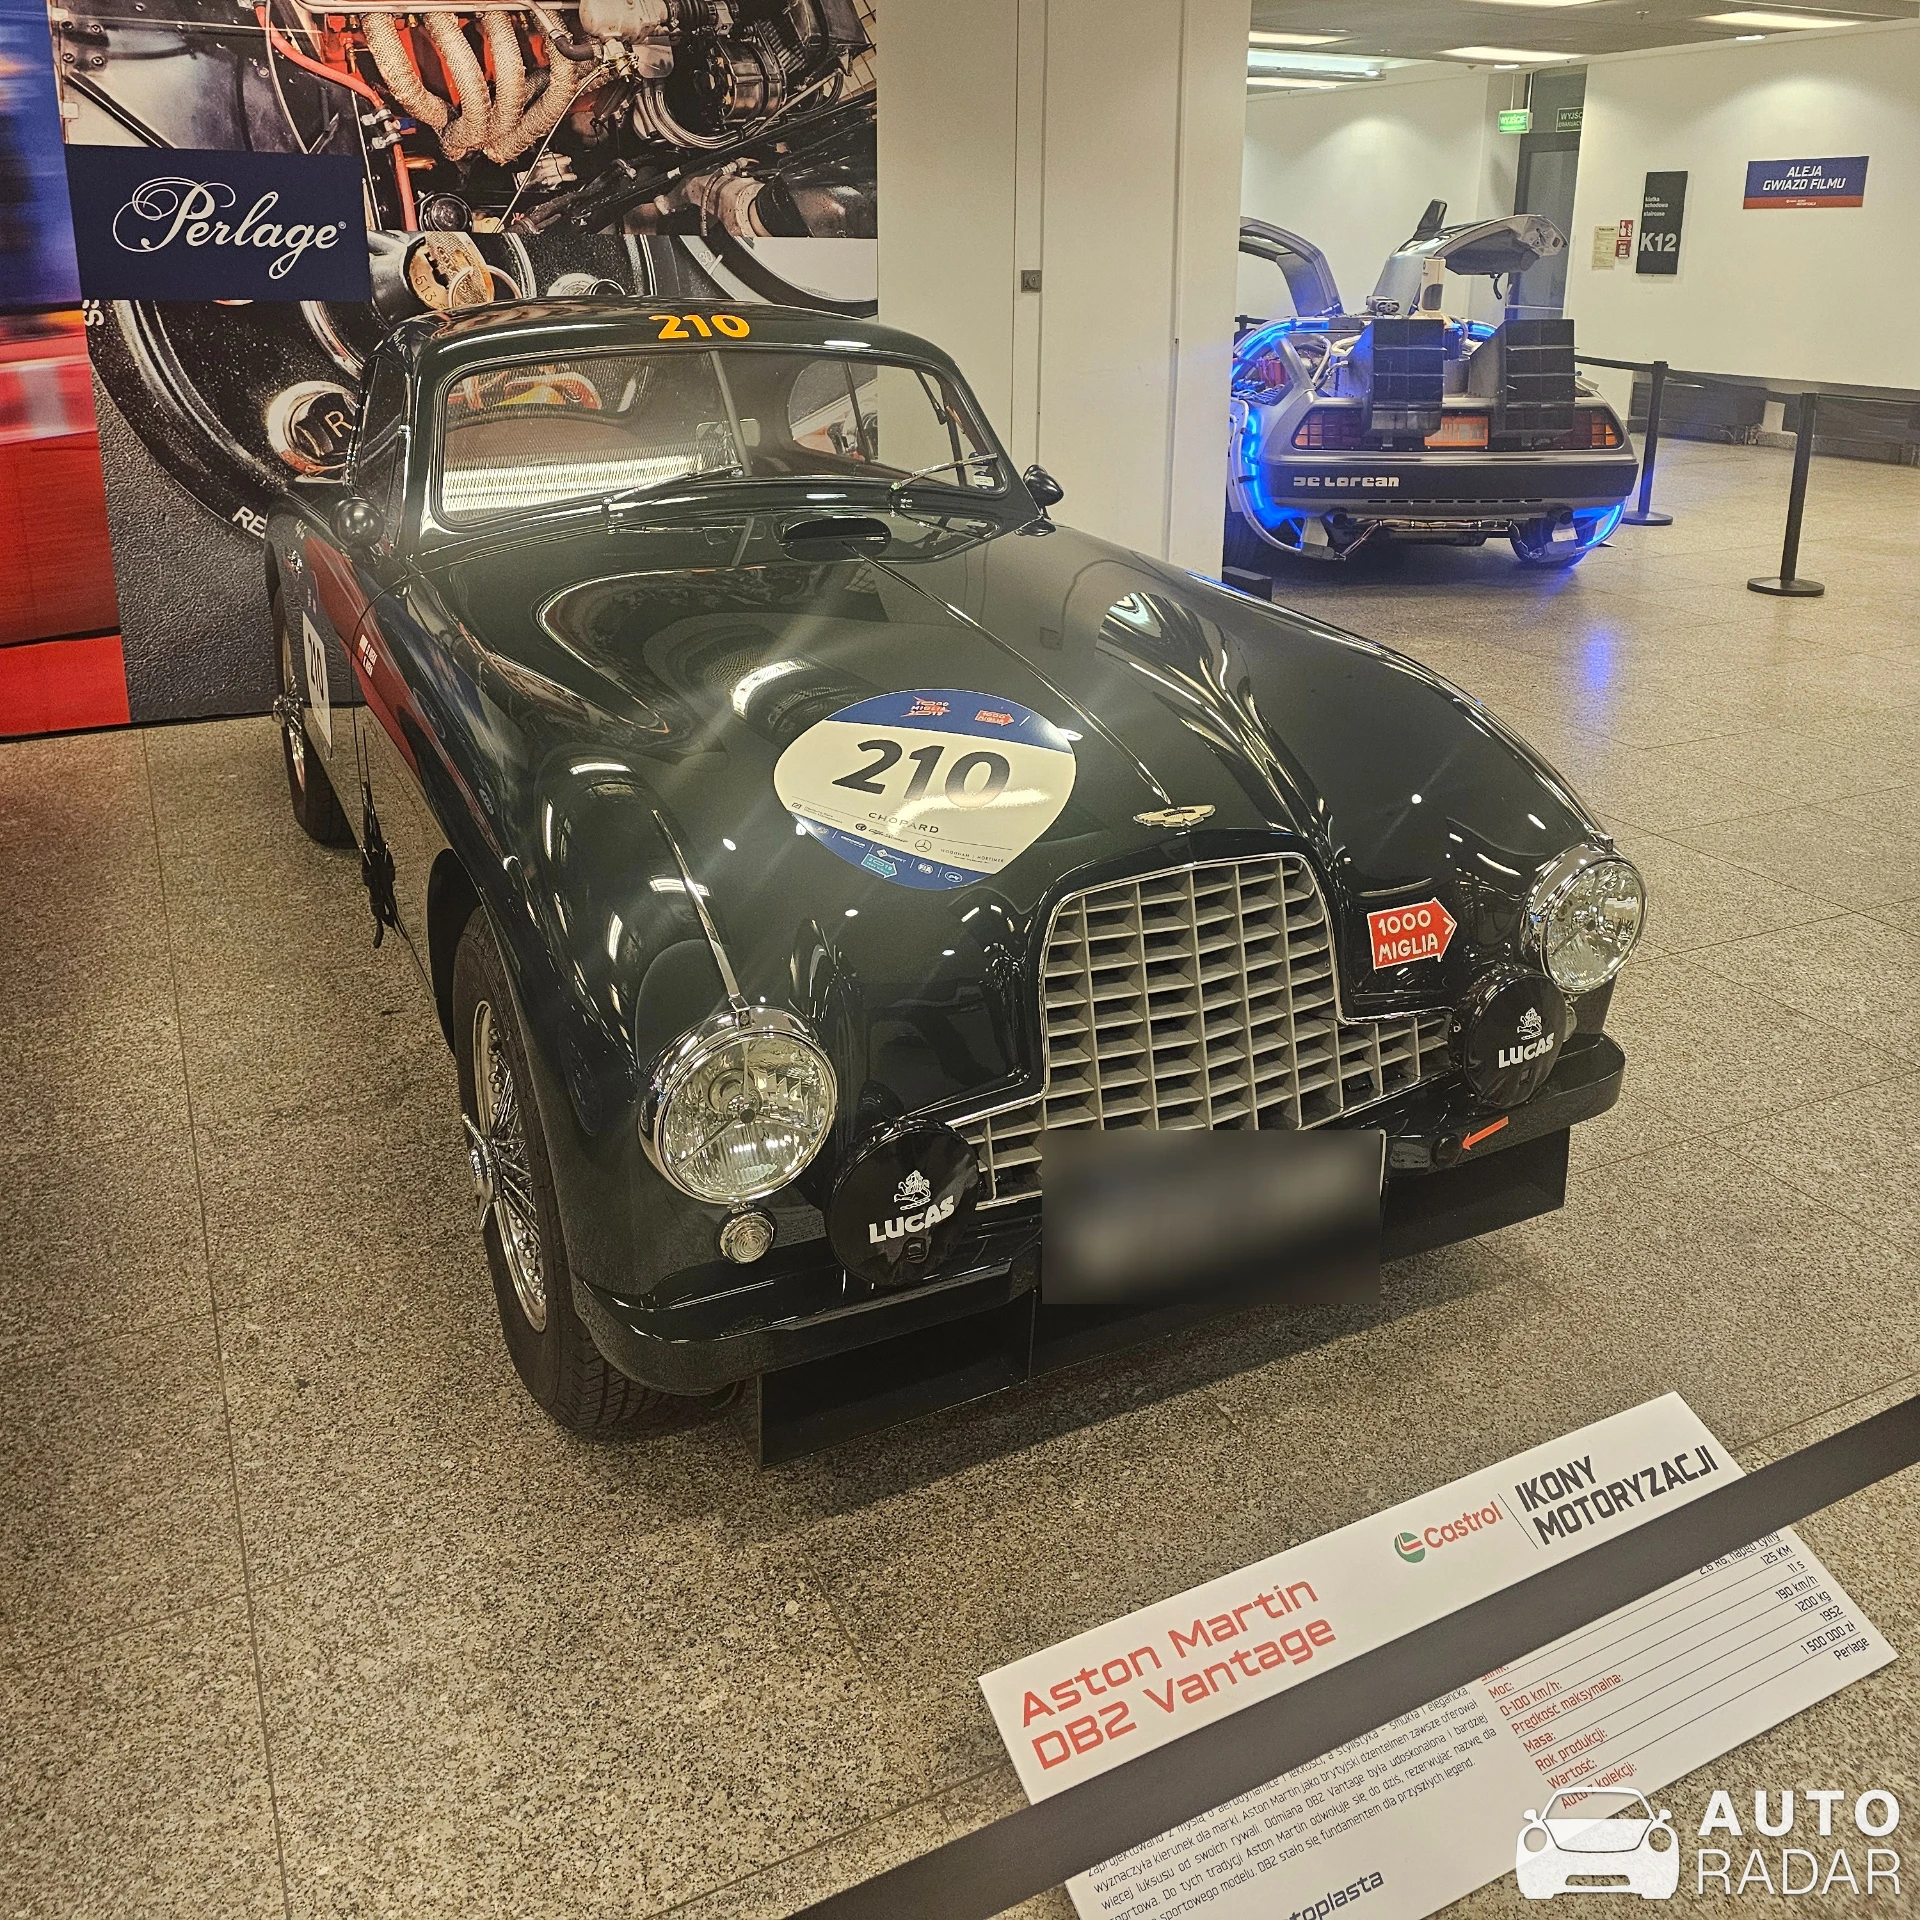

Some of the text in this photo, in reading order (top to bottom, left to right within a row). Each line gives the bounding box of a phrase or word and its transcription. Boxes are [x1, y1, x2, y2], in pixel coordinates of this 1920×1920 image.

[1763, 178, 1846, 191] GWIAZD FILMU
[1787, 166, 1822, 177] ALEJA
[1640, 232, 1677, 252] K12
[648, 314, 750, 340] 210
[831, 739, 1011, 809] 210
[868, 812, 940, 834] CHOPARD
[1378, 909, 1431, 936] 1000
[1378, 933, 1438, 963] MIGLIA
[1498, 1033, 1555, 1069] LUCAS
[868, 1195, 955, 1244] LUCAS
[1514, 1455, 1599, 1513] IKONY
[1532, 1445, 1719, 1546] MOTORYZACJI
[1423, 1501, 1503, 1549] Castrol
[1760, 1544, 1793, 1566] 125 KM
[1787, 1561, 1806, 1574] 11 s
[1775, 1574, 1819, 1600] 190 km/h
[1795, 1590, 1832, 1612] 1200 kg
[1819, 1605, 1844, 1622] 1952
[1800, 1621, 1856, 1655] 1 500 000 zł
[1833, 1637, 1870, 1661] Perlage
[1022, 1580, 1319, 1728] Aston Martin
[1031, 1618, 1337, 1771] DB2 Vantage
[1428, 1687, 1472, 1712] elegancka,
[1488, 1681, 1515, 1699] Moc:
[1500, 1680, 1563, 1717] 0-100 km/h:
[1511, 1673, 1624, 1735] Prędkość maksymalna:
[1522, 1731, 1556, 1753] Masa:
[1535, 1727, 1609, 1772] Rok produkcji:
[1547, 1757, 1598, 1789] Wartość:
[1595, 1761, 1638, 1788] kolekcji:
[1094, 1857, 1153, 1894] wyznaczyła
[1153, 1836, 1196, 1865] kierunek
[1196, 1830, 1212, 1844] dla
[1212, 1814, 1242, 1836] marki.
[1242, 1801, 1271, 1821] Aston
[1270, 1781, 1302, 1807] Martin
[1302, 1776, 1321, 1794] jako
[1320, 1757, 1360, 1784] brytyjski
[1409, 1720, 1442, 1739] zawsze
[1441, 1699, 1479, 1724] oferował
[1101, 1886, 1134, 1911] więcej
[1136, 1867, 1175, 1894] luksusu
[1177, 1858, 1192, 1873] od
[1194, 1841, 1229, 1864] swoich
[1230, 1824, 1263, 1847] rywali.
[1264, 1803, 1303, 1829] Odmiana
[1305, 1792, 1325, 1809] DB2
[1327, 1774, 1366, 1798] Vantage
[1367, 1762, 1388, 1779] była
[1390, 1733, 1447, 1767] udoskonalona
[1453, 1712, 1489, 1736] bardziej
[1162, 1887, 1178, 1901] Do
[1179, 1873, 1204, 1891] tych
[1206, 1852, 1244, 1878] tradycji
[1246, 1838, 1275, 1859] Aston
[1275, 1821, 1308, 1844] Martin
[1310, 1799, 1351, 1826] odwołuje
[1351, 1792, 1367, 1805] się
[1369, 1785, 1381, 1797] do
[1382, 1773, 1404, 1790] dziś,
[1404, 1749, 1453, 1779] rezerwując
[1453, 1735, 1484, 1755] nazwę
[1484, 1727, 1497, 1740] dla
[1220, 1869, 1258, 1892] modelu.
[1257, 1855, 1279, 1873] DB2
[1279, 1842, 1305, 1861] stało
[1305, 1836, 1322, 1850] się
[1320, 1804, 1383, 1842] fundamentem
[1383, 1796, 1398, 1811] dla
[1397, 1772, 1445, 1803] przyszłych
[1446, 1757, 1476, 1779] legend.
